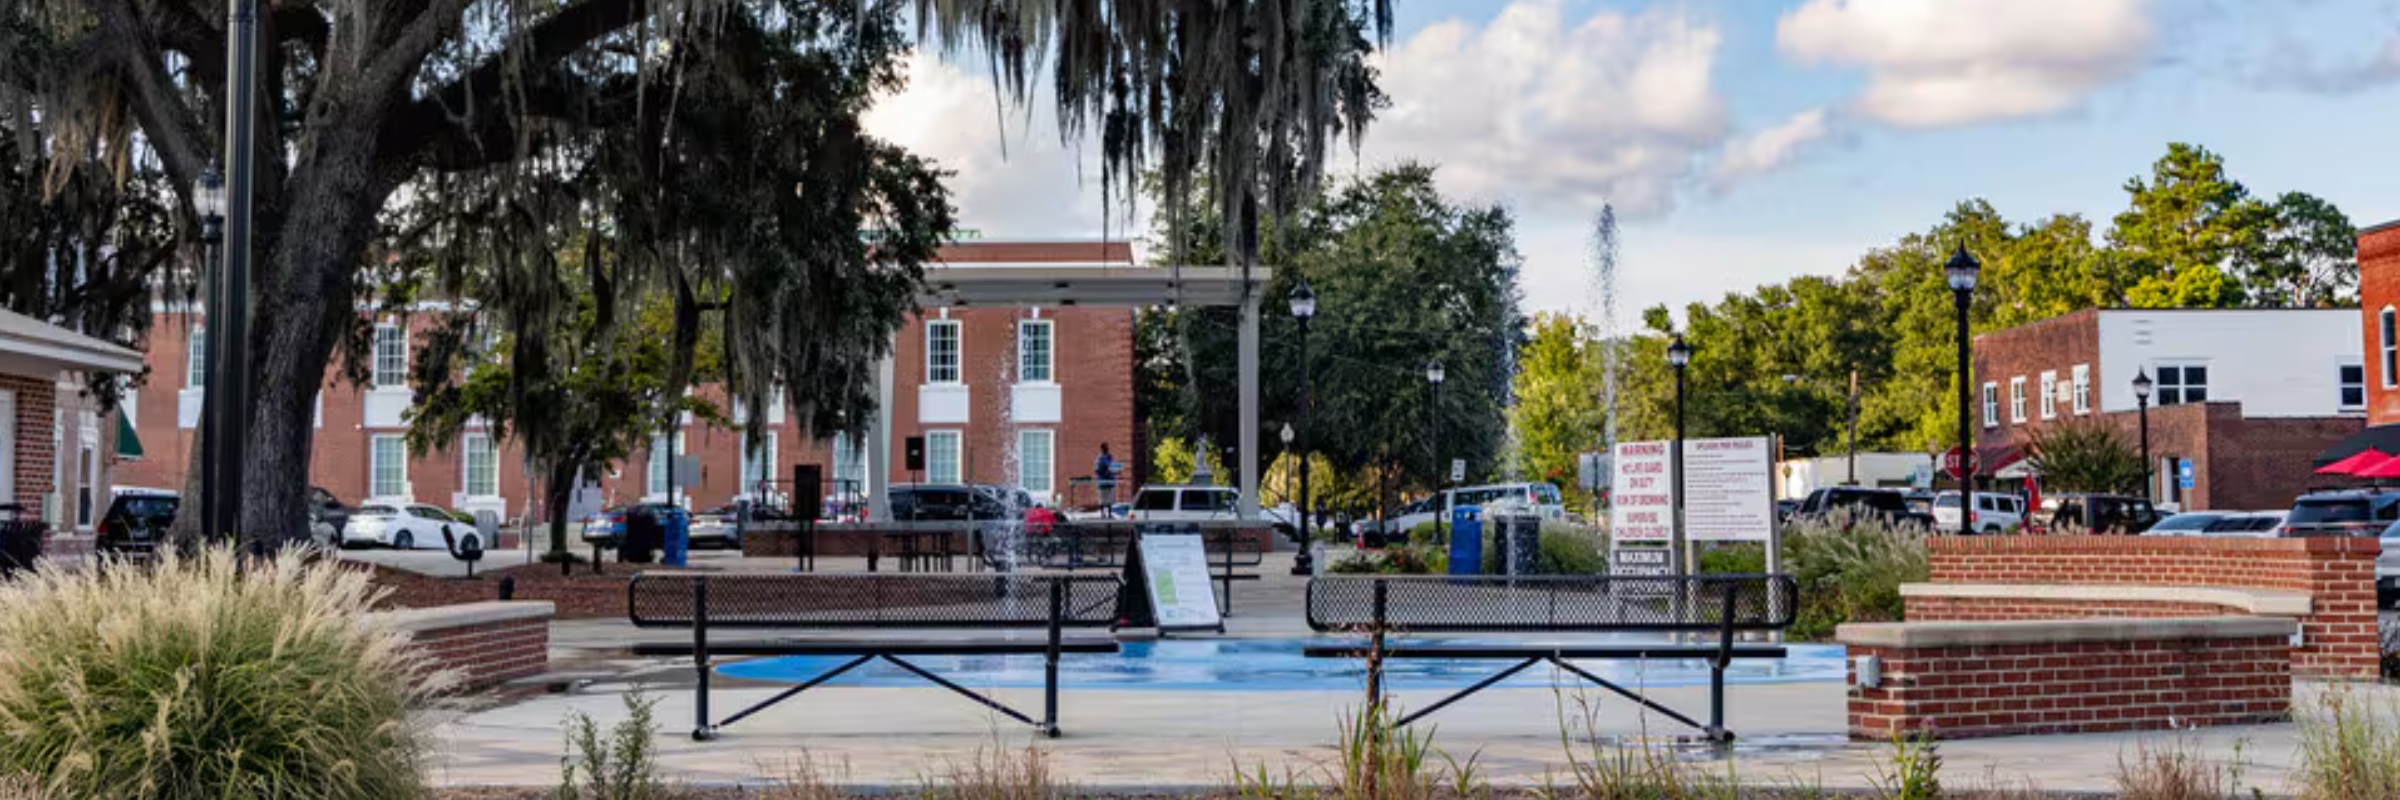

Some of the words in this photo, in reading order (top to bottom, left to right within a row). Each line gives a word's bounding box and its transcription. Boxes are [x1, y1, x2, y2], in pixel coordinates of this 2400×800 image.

[1620, 444, 1665, 455] WARNING
[1947, 454, 1976, 468] STP
[1619, 552, 1664, 563] MAXIMUM
